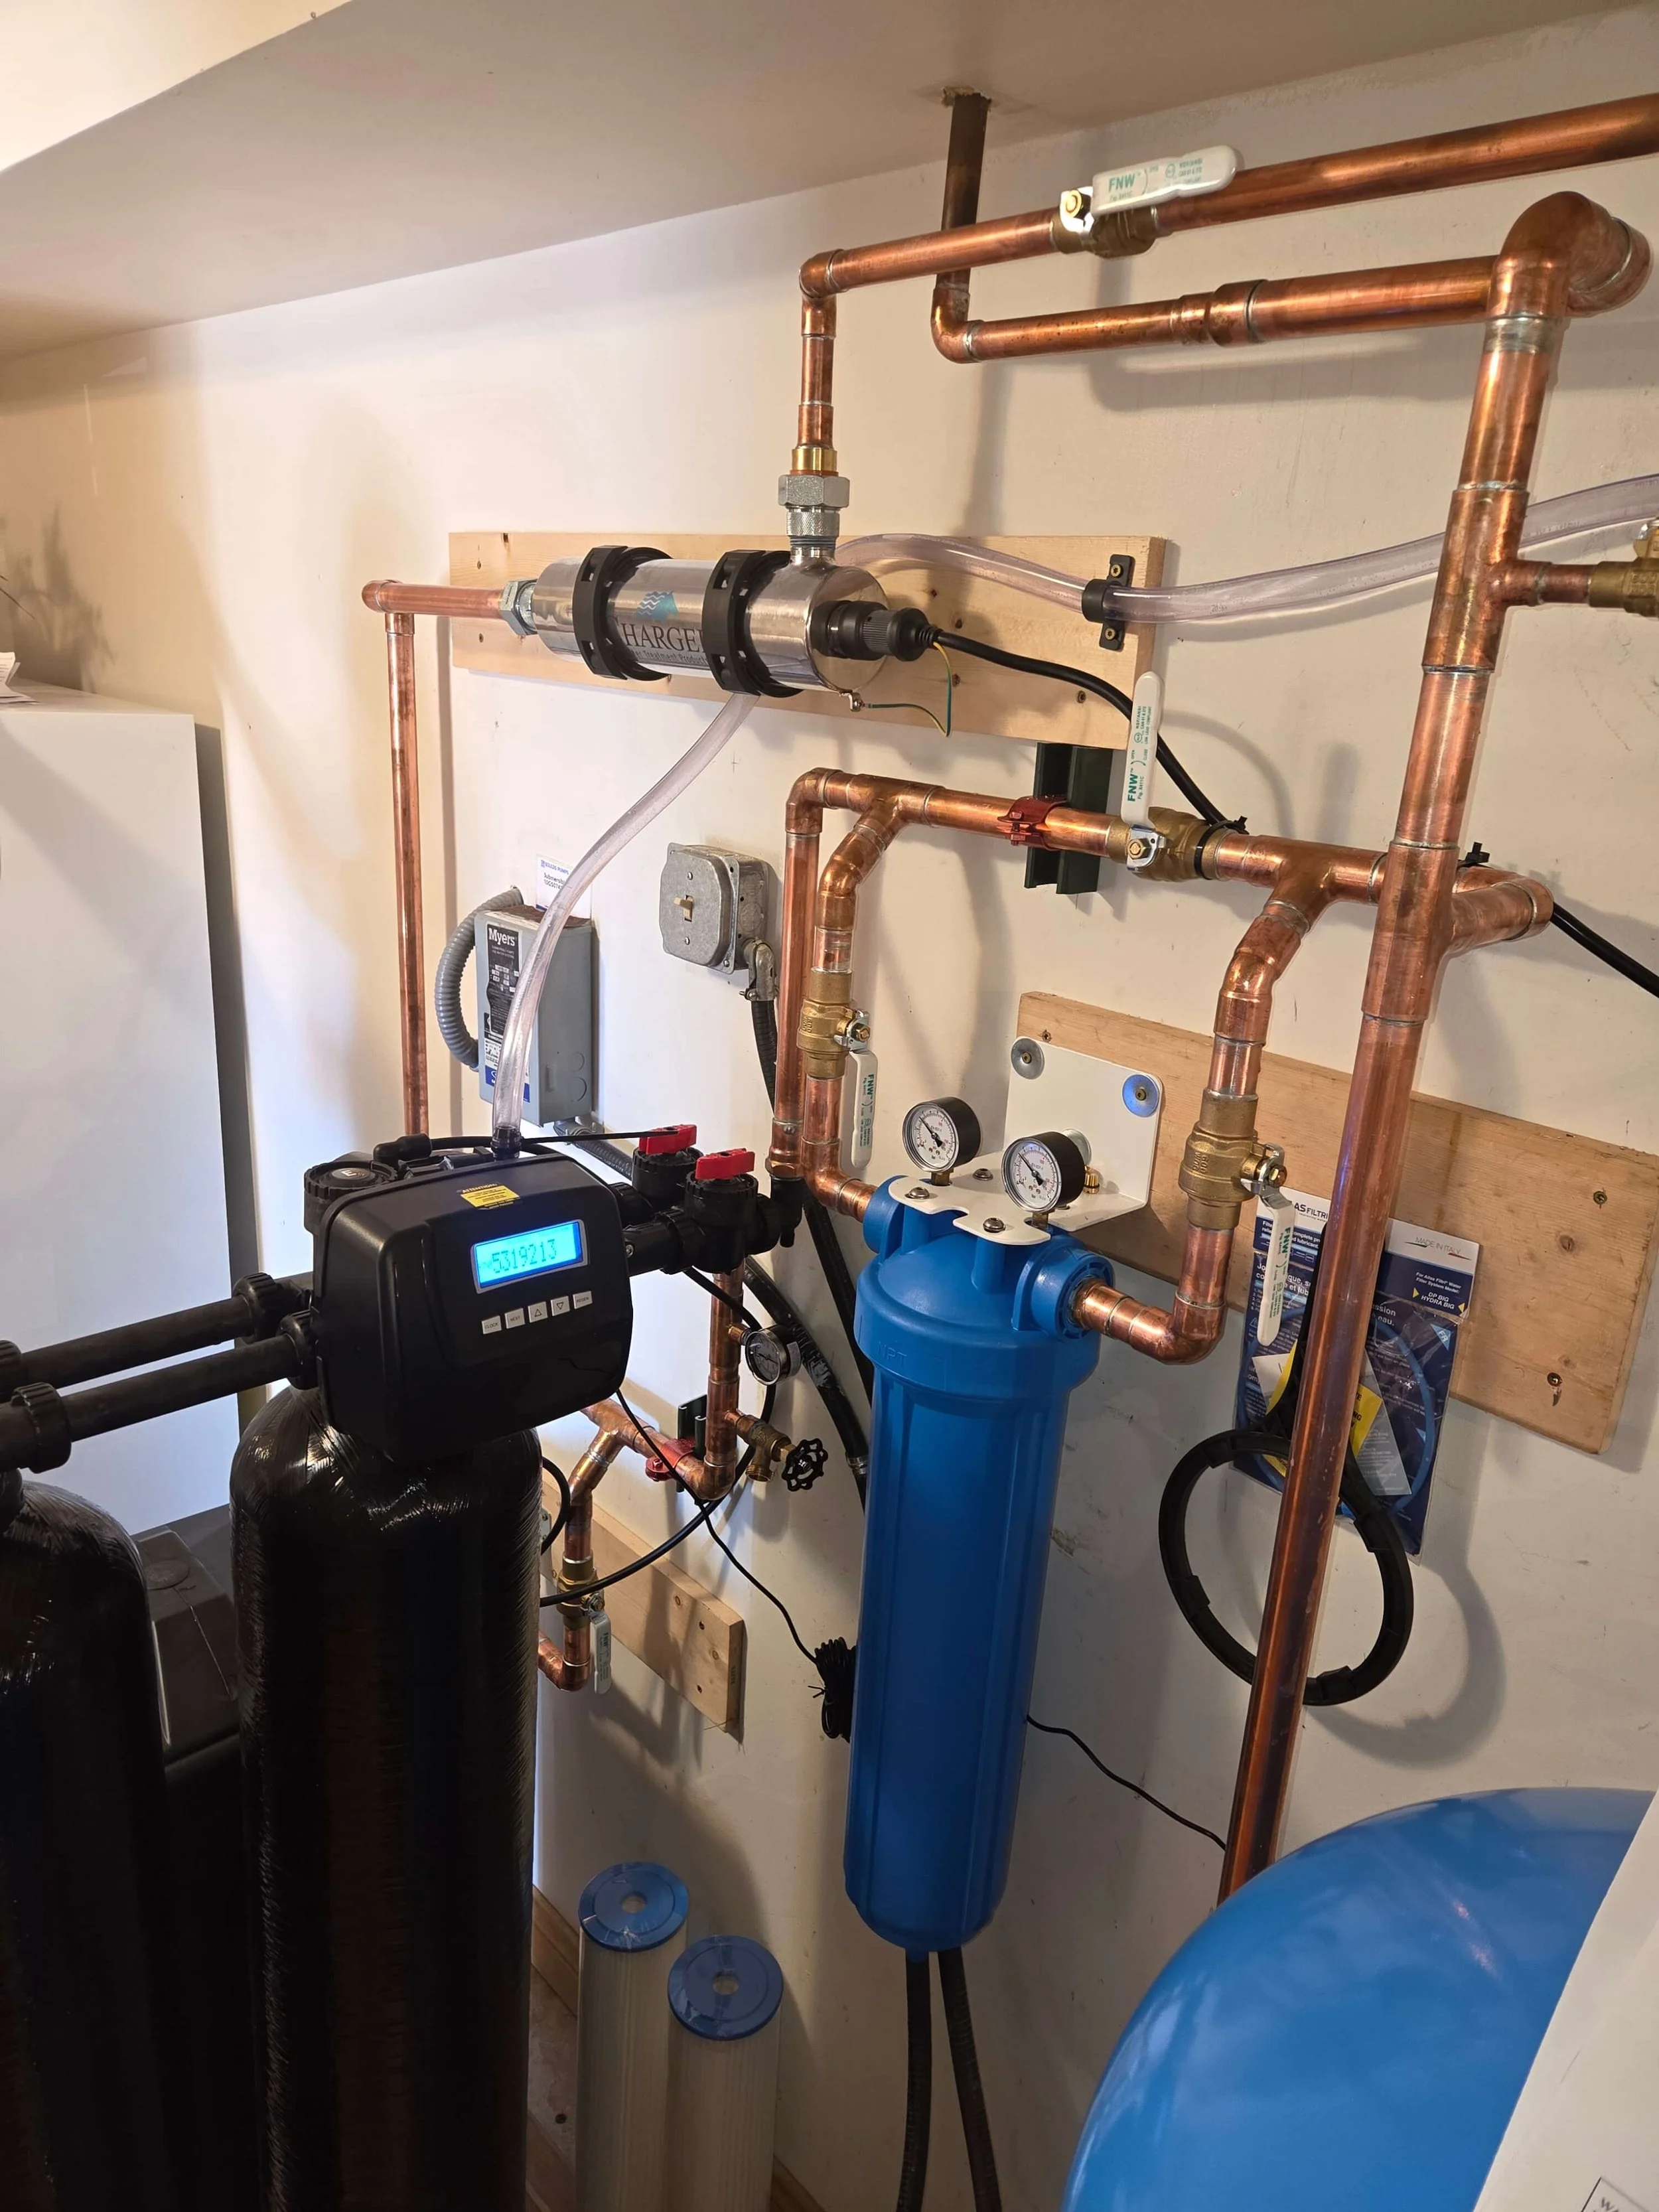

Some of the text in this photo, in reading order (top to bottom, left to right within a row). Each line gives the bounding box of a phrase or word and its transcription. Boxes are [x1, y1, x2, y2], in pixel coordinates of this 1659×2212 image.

[1108, 173, 1135, 192] FNW
[613, 615, 705, 653] HARGE
[1127, 774, 1138, 802] FNW
[488, 927, 515, 946] Myers
[1281, 1227, 1291, 1254] FNW
[1415, 1236, 1435, 1248] MADE
[1443, 1245, 1461, 1254] ITALY
[1421, 1295, 1442, 1306] HYDRA
[1438, 1330, 1449, 1342] FR
[877, 1341, 907, 1368] NPT
